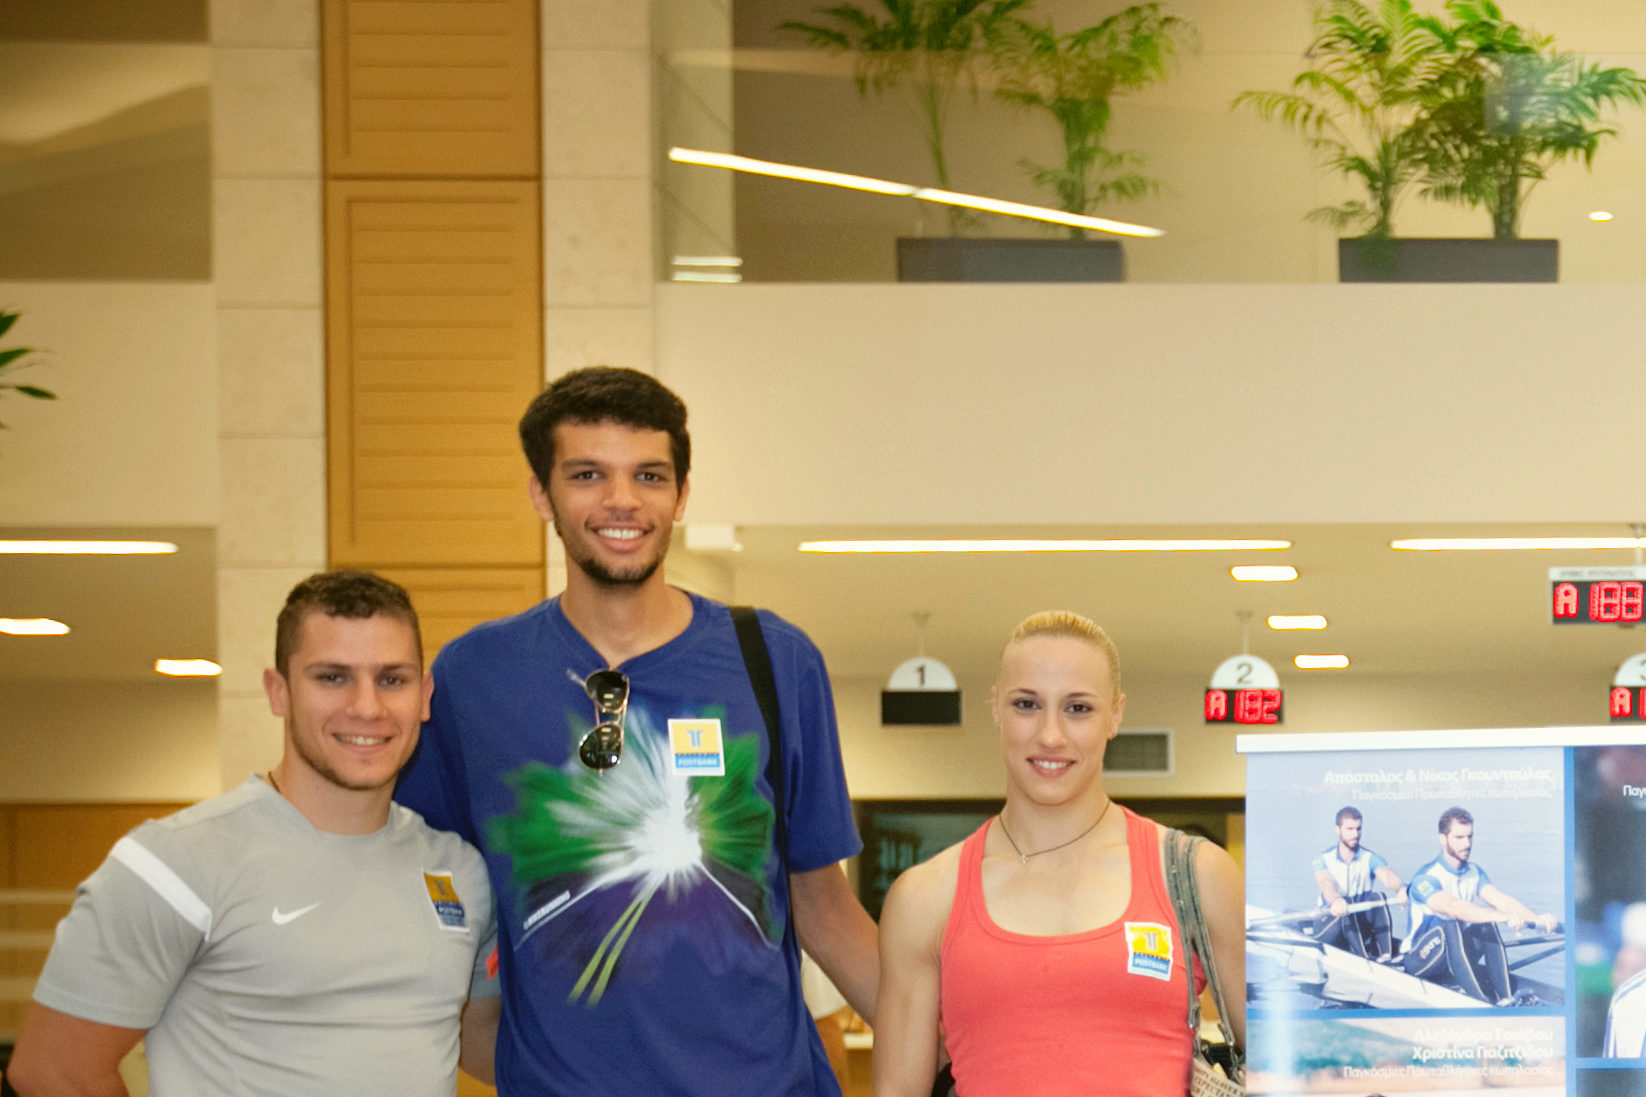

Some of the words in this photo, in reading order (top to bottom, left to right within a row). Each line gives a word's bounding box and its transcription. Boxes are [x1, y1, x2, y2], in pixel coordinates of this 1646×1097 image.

[916, 665, 926, 687] 1
[1236, 663, 1253, 684] 2
[1405, 769, 1416, 783] &
[1418, 768, 1459, 784] Νίκος
[1412, 1045, 1475, 1061] Χριστίνα
